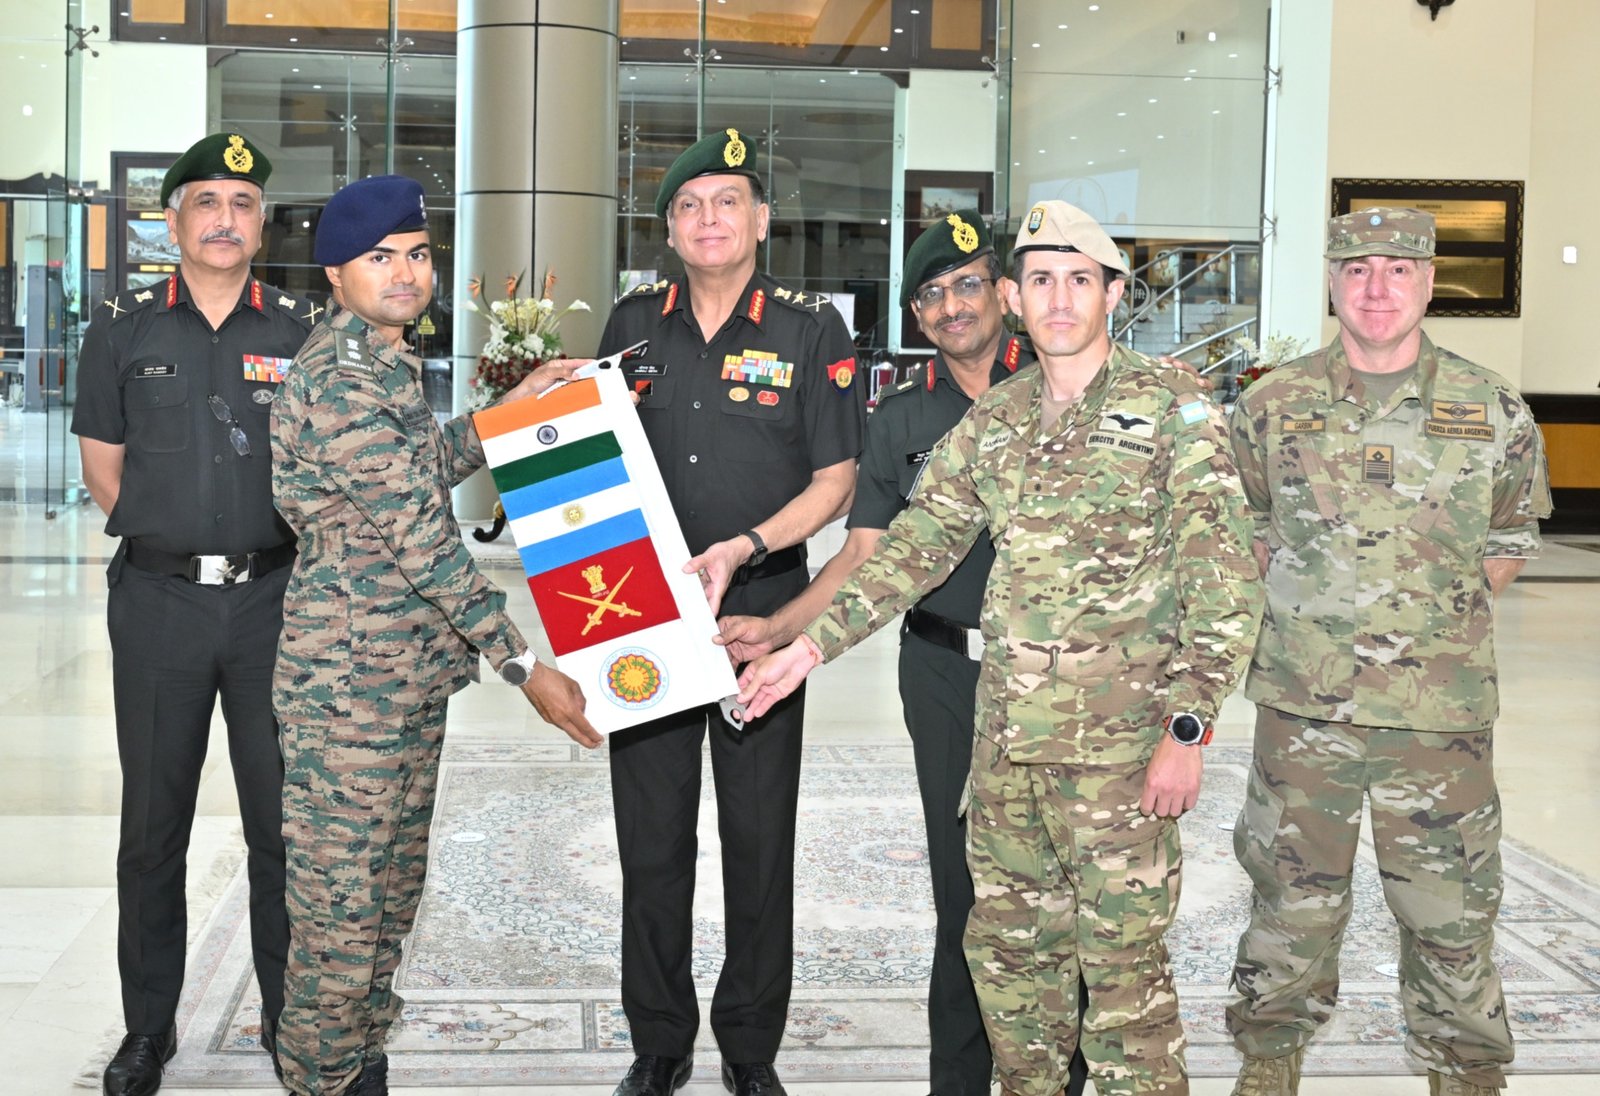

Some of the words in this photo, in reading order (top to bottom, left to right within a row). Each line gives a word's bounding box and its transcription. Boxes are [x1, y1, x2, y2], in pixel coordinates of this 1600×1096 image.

[1428, 424, 1446, 434] FUERZA
[1464, 427, 1492, 437] ARGENTINA
[1118, 440, 1154, 455] ARGENTINO
